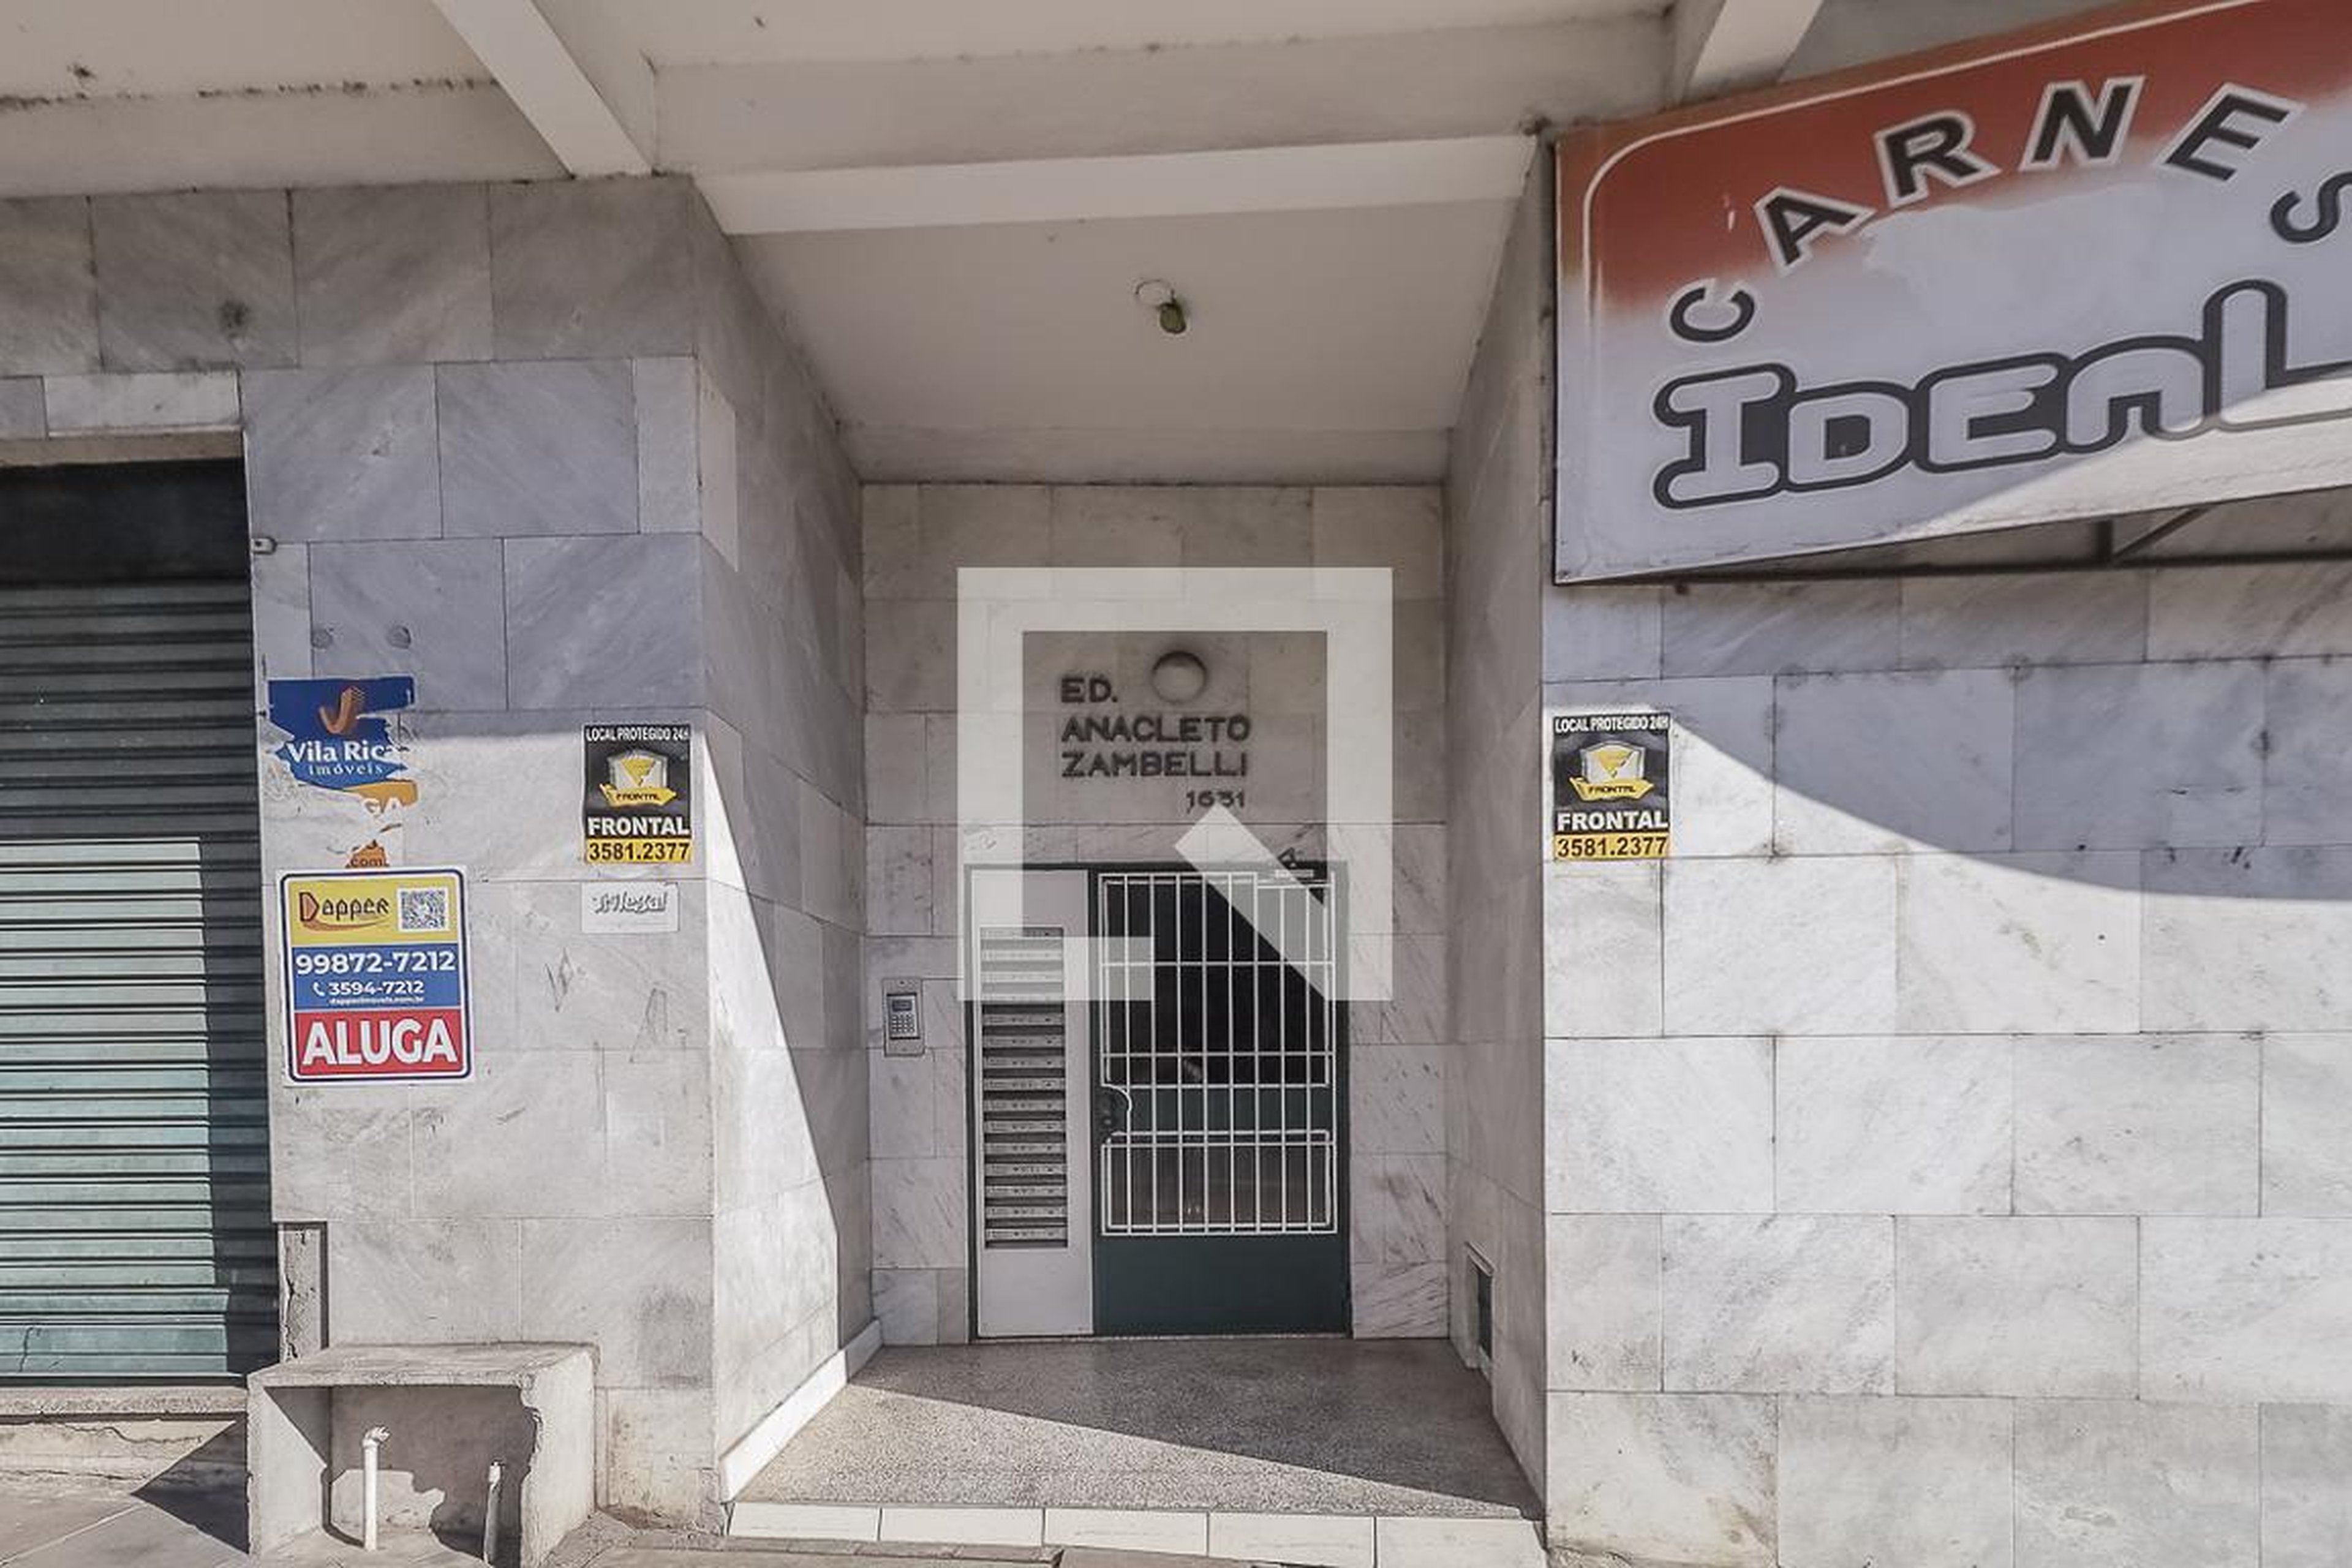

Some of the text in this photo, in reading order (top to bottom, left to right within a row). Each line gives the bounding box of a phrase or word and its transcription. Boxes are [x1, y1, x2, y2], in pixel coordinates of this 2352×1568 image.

[1668, 75, 2352, 344] CARNES
[1060, 677, 1118, 704] ED.
[586, 727, 616, 742] LOCAL
[617, 726, 671, 741] PROTEGIDO
[1061, 715, 1251, 743] ANACLETO
[1555, 718, 1589, 733] LOCAL
[1591, 715, 1649, 731] PROTEGIDO
[285, 740, 337, 764] Vila
[309, 763, 383, 776] imóveis
[1062, 752, 1247, 777] ZAMBELLI
[588, 816, 689, 835] FRONTAL
[1557, 810, 1668, 831] FRONTAL
[589, 842, 690, 861] 3581.2377
[1558, 837, 1667, 857] 3581.2377
[295, 951, 456, 974] 99872-7212
[328, 980, 424, 995] 3594-7212
[302, 1019, 458, 1065] ALUGA
